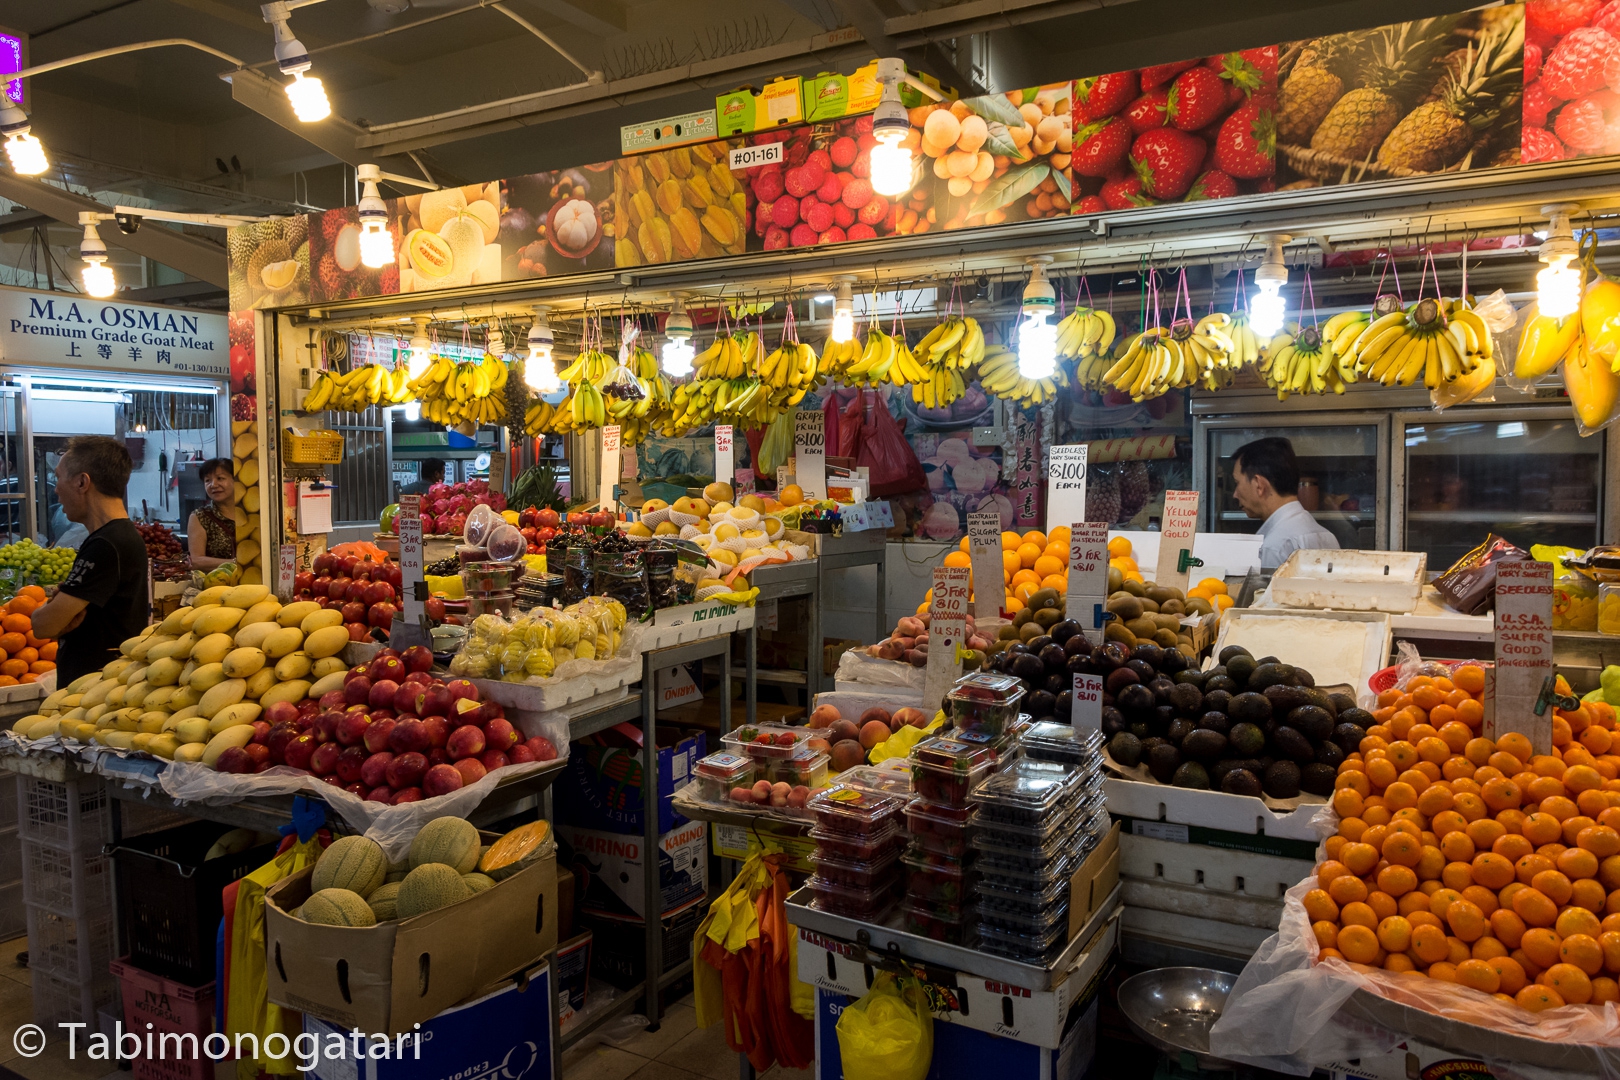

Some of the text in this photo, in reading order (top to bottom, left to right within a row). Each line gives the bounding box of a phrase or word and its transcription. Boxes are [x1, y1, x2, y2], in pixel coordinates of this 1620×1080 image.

[818, 85, 843, 99] Zespri
[723, 103, 746, 116] Zespri
[734, 147, 778, 165] #01-161
[29, 297, 199, 335] M.A. OSMAN
[10, 319, 214, 351] Premium Grade Goat Meat
[65, 341, 172, 365] 上等羊肉
[795, 412, 824, 422] GRAPE
[795, 422, 823, 432] FRUIT
[716, 435, 723, 445] 3
[1051, 446, 1087, 455] SEEDLESS
[401, 511, 408, 519] 3
[1166, 506, 1198, 517] YELLOW
[1169, 519, 1192, 528] KIWI
[400, 532, 422, 545] 3 FOR
[969, 528, 1001, 537] SUGAR
[1163, 529, 1189, 538] GOLD
[973, 538, 997, 546] PLUM
[1070, 546, 1102, 561] 3 FOR
[280, 556, 287, 571] 3
[1497, 562, 1553, 571] SUGAR ORANGE
[1498, 570, 1550, 579] VERY SWEET
[934, 581, 969, 599] 3 FOR
[1496, 584, 1553, 595] SEEDLESS
[1501, 613, 1544, 626] U.S.A.
[934, 626, 961, 637] USA
[1500, 633, 1551, 645] SUPER
[1502, 643, 1542, 655] GOOD
[1497, 657, 1551, 668] TANGERINES
[1074, 677, 1103, 691] 3 FOR
[664, 684, 696, 701] KARINO
[575, 757, 637, 824] PIET CITRUS
[665, 825, 703, 851] KARINO
[572, 833, 639, 859] KARINO
[814, 974, 850, 993] Premium
[984, 980, 1032, 998] GROWN
[150, 1005, 164, 1017] FOR
[164, 1009, 182, 1025] SALE
[993, 1022, 1021, 1037] Fruit
[1324, 1061, 1379, 1079] Premium
[1432, 1061, 1488, 1078] KINGSBUR
